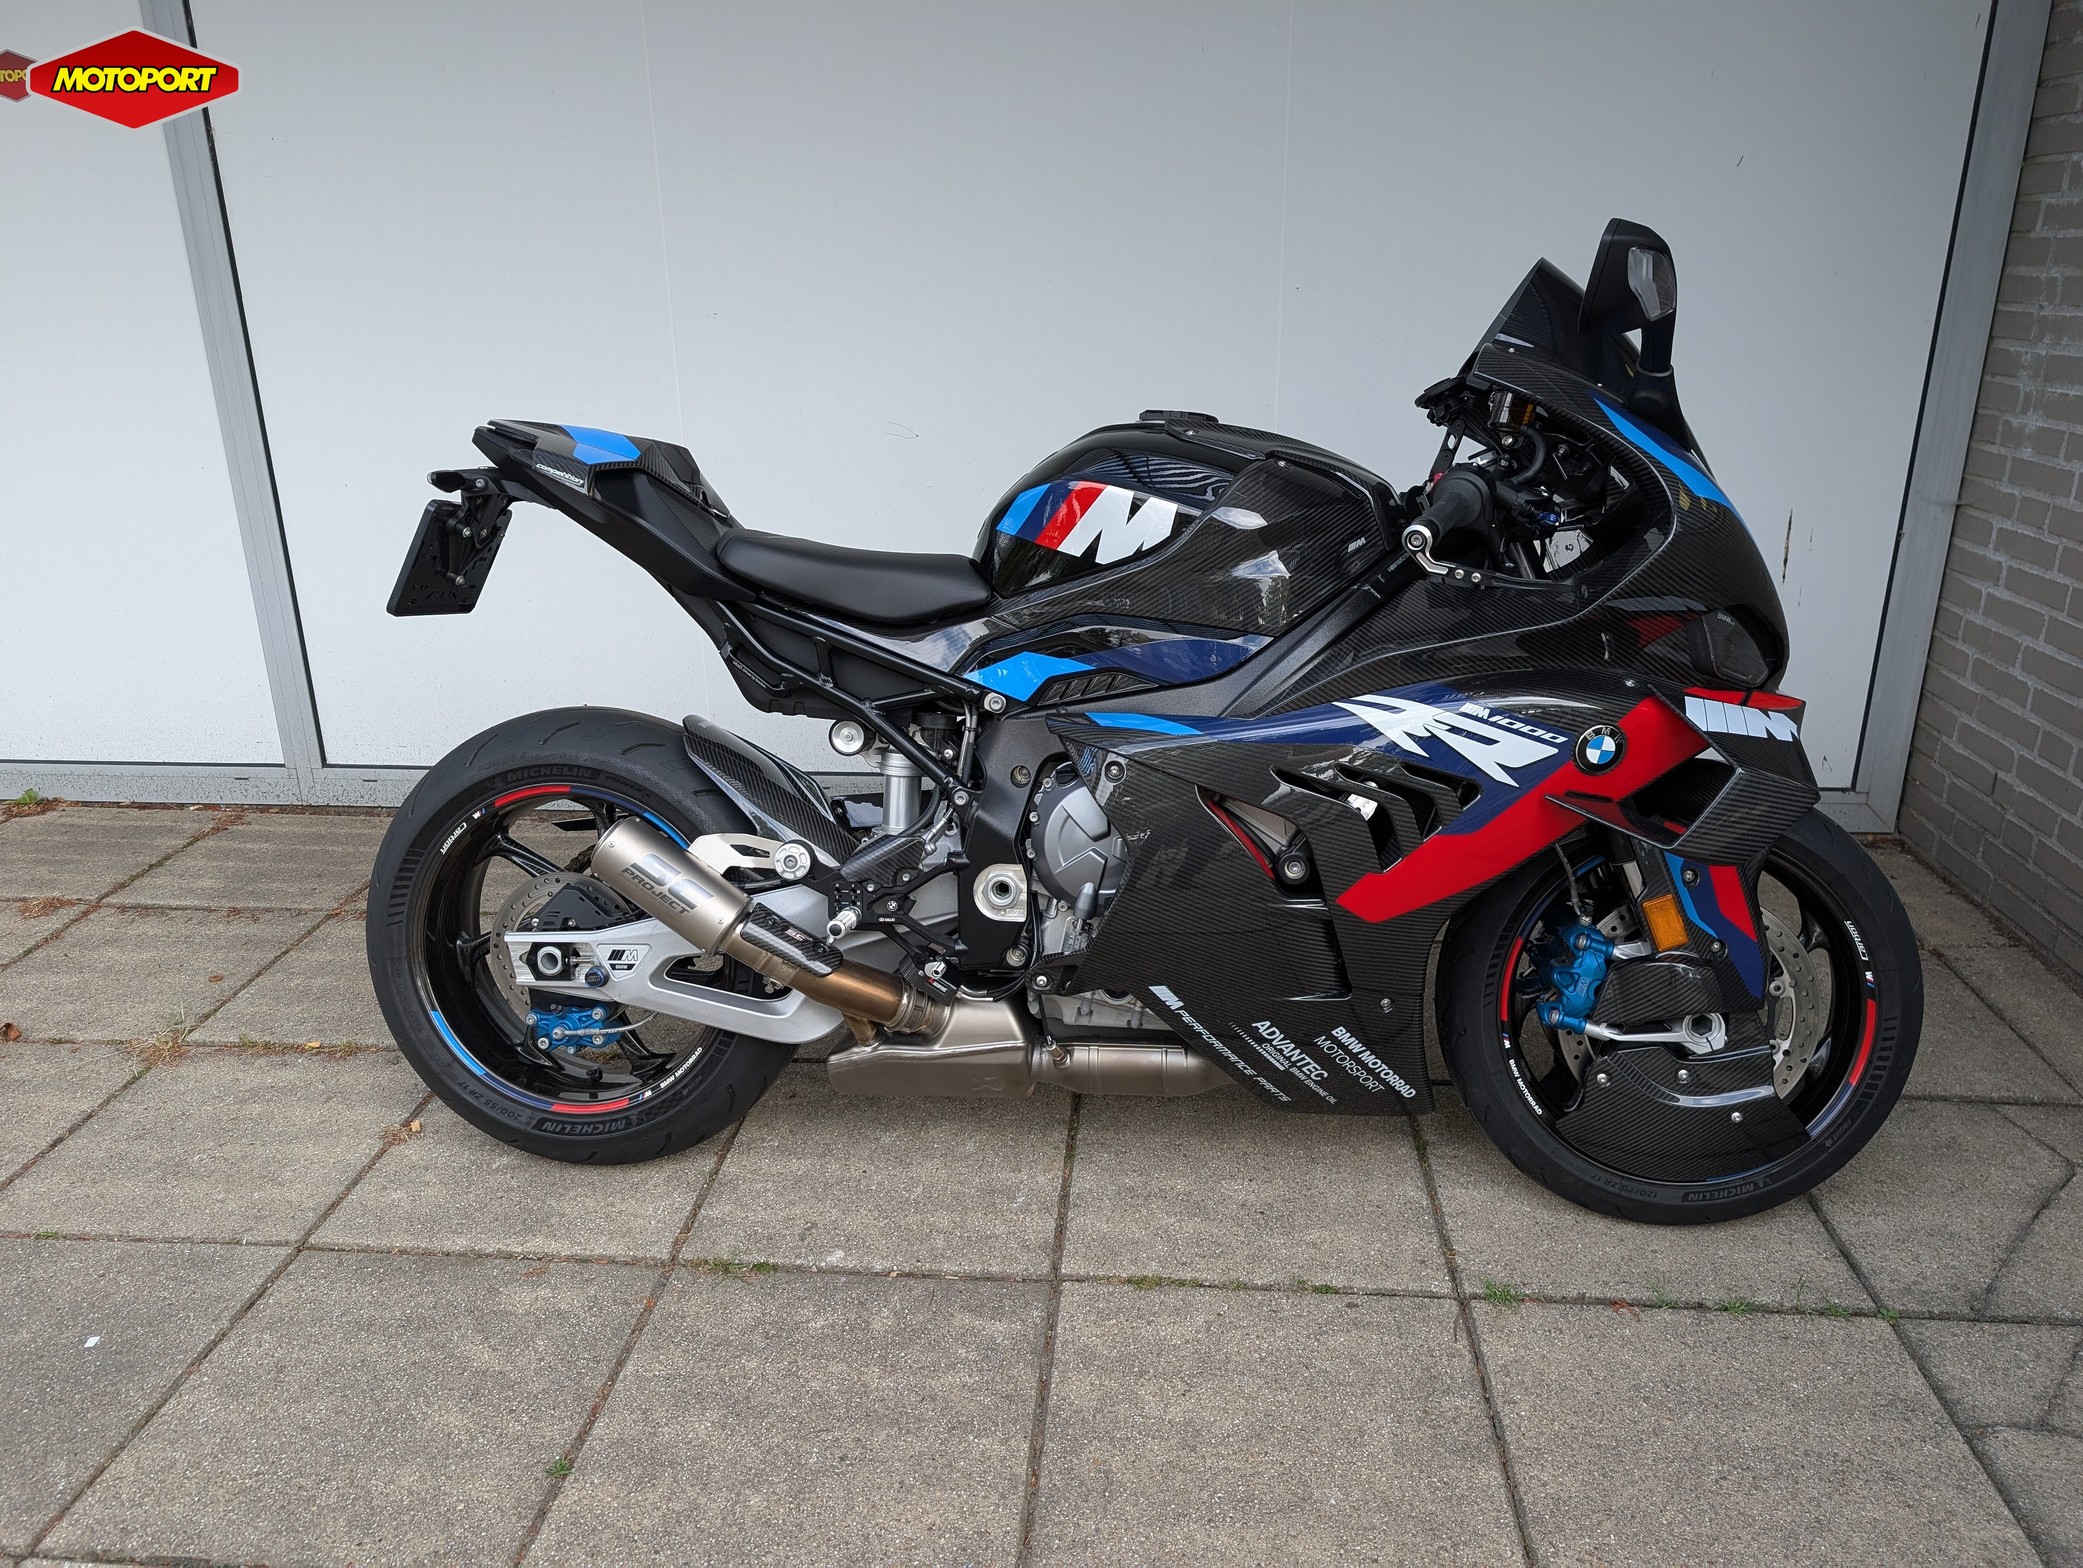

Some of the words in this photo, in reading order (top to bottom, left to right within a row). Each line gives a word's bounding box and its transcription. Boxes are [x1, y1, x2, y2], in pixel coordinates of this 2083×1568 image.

[536, 463, 585, 486] competition
[1585, 726, 1624, 744] BMW
[506, 765, 593, 782] MICHELIN
[621, 867, 690, 915] PROJECT
[629, 853, 715, 911] SC
[1174, 1009, 1258, 1076] PERFORMANCE
[1253, 1076, 1292, 1102] PARTS
[1251, 1020, 1329, 1081] ADVANTEC
[1331, 1025, 1367, 1053] BMW
[1359, 1050, 1417, 1099] MOTORRAD
[659, 1074, 675, 1089] BMW
[674, 1046, 703, 1078] MOTORRAD
[1261, 1043, 1290, 1070] ORIGINAL
[1289, 1067, 1306, 1082] BMW
[1304, 1079, 1329, 1098] ENGINE
[1325, 1095, 1338, 1105] OIL
[1313, 1035, 1385, 1093] MOTORSPORT
[457, 1080, 470, 1090] 17
[468, 1088, 485, 1100] ZR
[1508, 1059, 1520, 1077] BMW
[1516, 1077, 1543, 1115] MOTORRAD
[484, 1098, 523, 1121] 200/55
[542, 1118, 626, 1135] MICHELIN
[1590, 1174, 1602, 1182] 17
[1604, 1179, 1619, 1189] ZR
[1621, 1184, 1658, 1198] 120/70
[1688, 1183, 1755, 1201] MICHELIN
